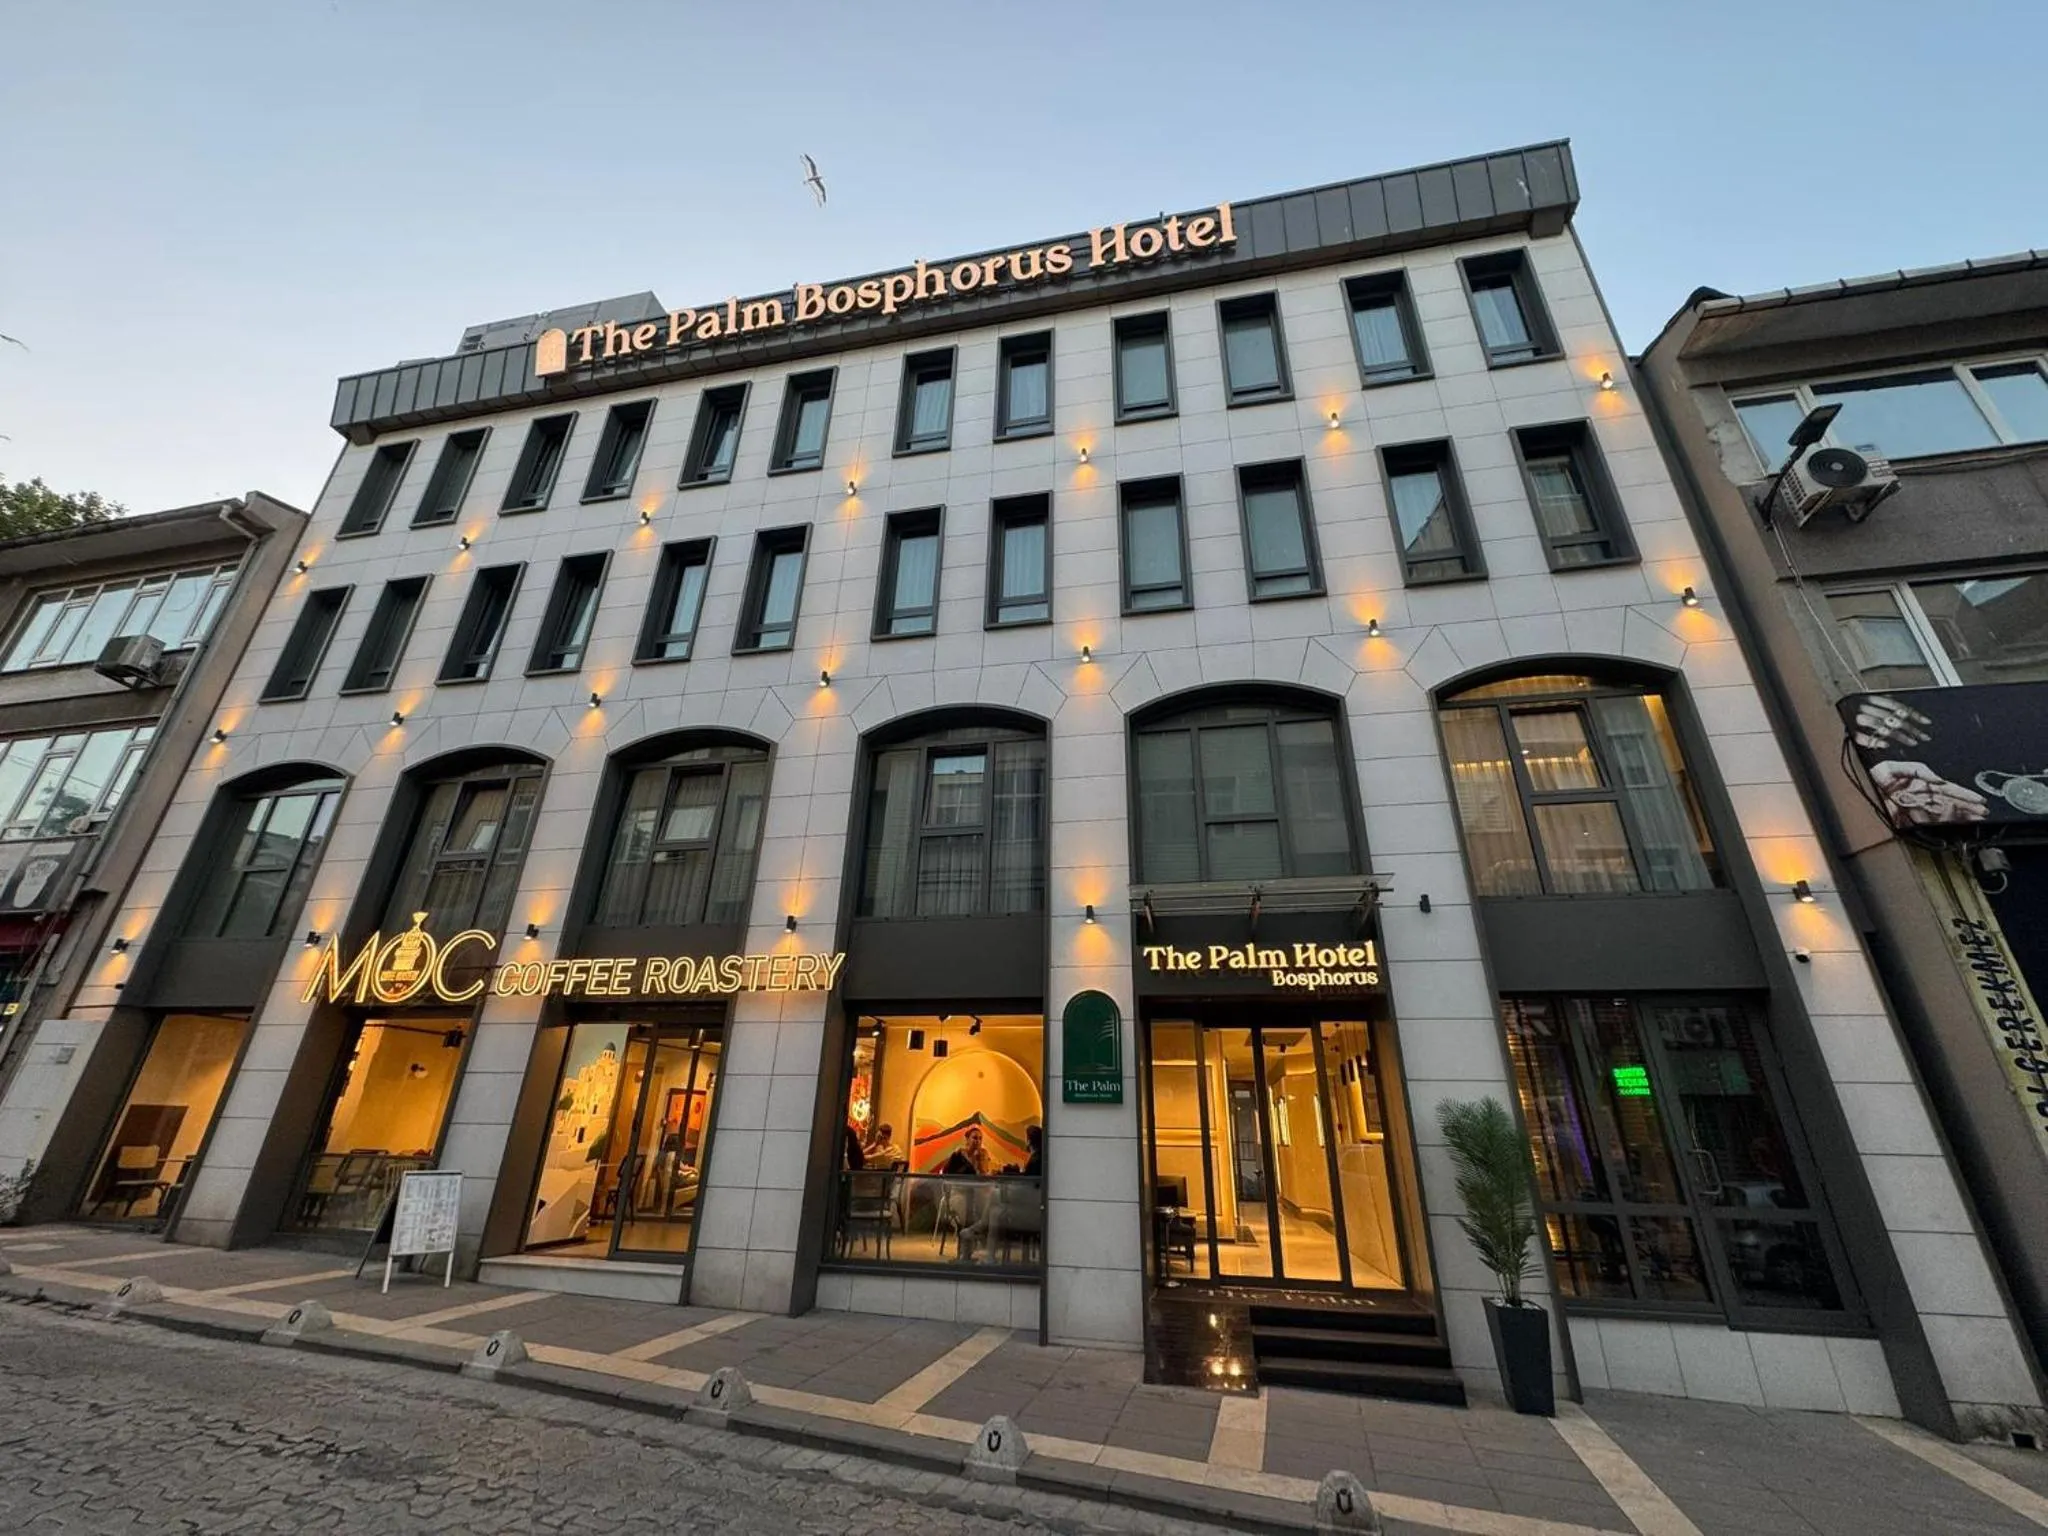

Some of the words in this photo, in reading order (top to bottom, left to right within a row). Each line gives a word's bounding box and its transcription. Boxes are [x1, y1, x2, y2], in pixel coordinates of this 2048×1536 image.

[571, 320, 654, 362] The
[666, 295, 785, 344] Palm
[794, 240, 1073, 316] Bosphorus
[1087, 202, 1236, 266] Hotel
[302, 924, 496, 1003] MOC
[494, 957, 637, 996] COFFEE
[641, 952, 846, 994] ROASTERY
[1143, 945, 1202, 971] The
[1209, 942, 1288, 970] Palm
[1292, 940, 1378, 968] Hotel
[1272, 969, 1379, 991] Bosphorus
[1065, 1079, 1089, 1092] The
[1092, 1079, 1121, 1092] Palm
